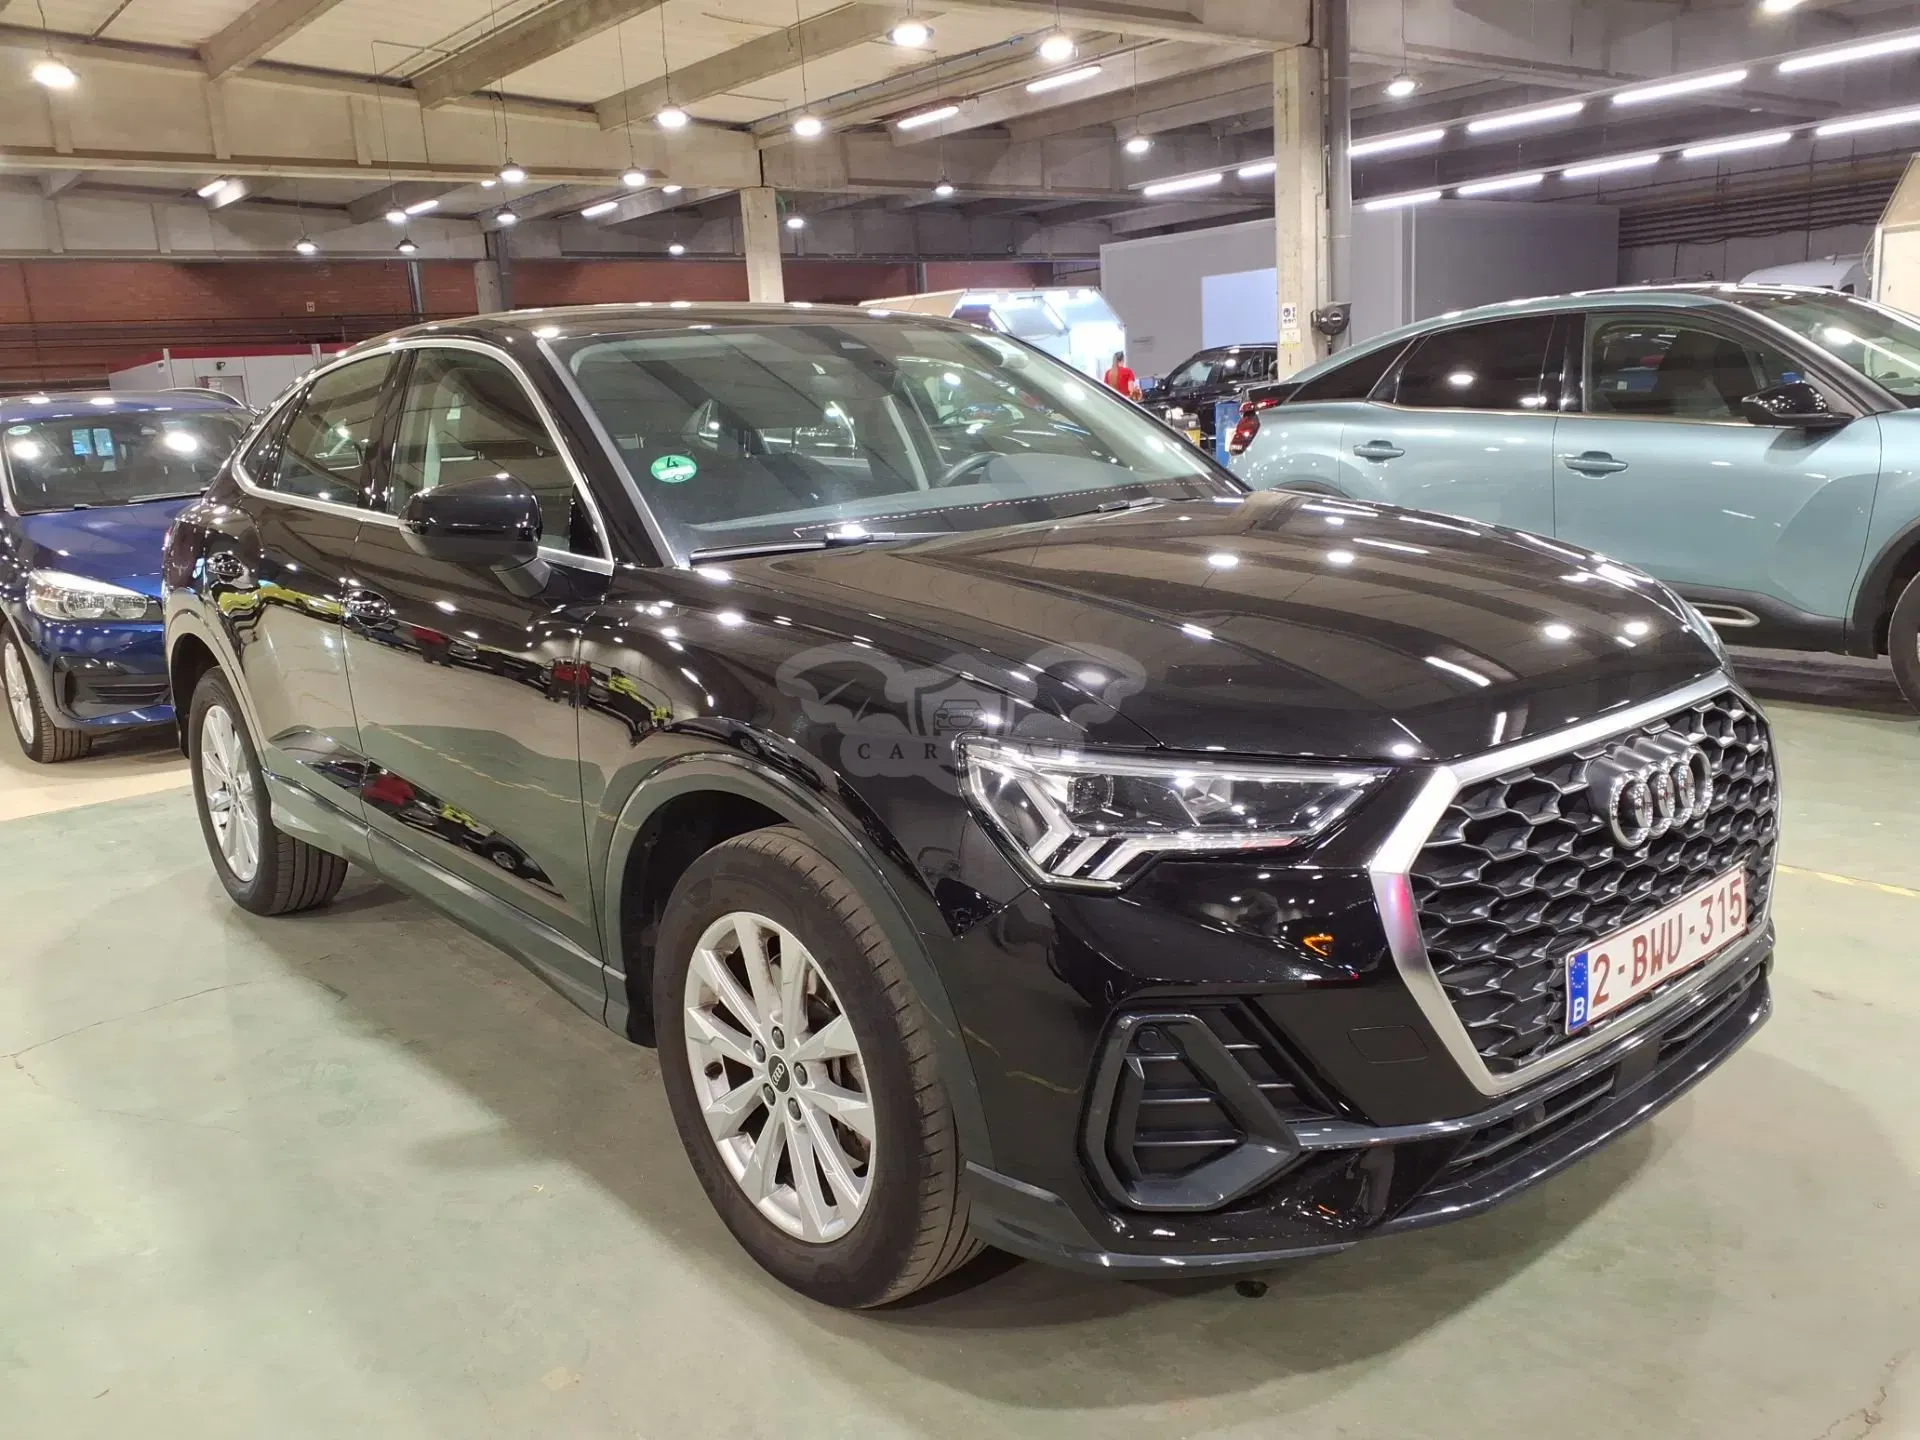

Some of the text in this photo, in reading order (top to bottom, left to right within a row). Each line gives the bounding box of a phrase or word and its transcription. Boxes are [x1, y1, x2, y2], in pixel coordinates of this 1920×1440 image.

[666, 457, 679, 468] 4
[1573, 878, 1743, 1023] B 2-BWU-315
